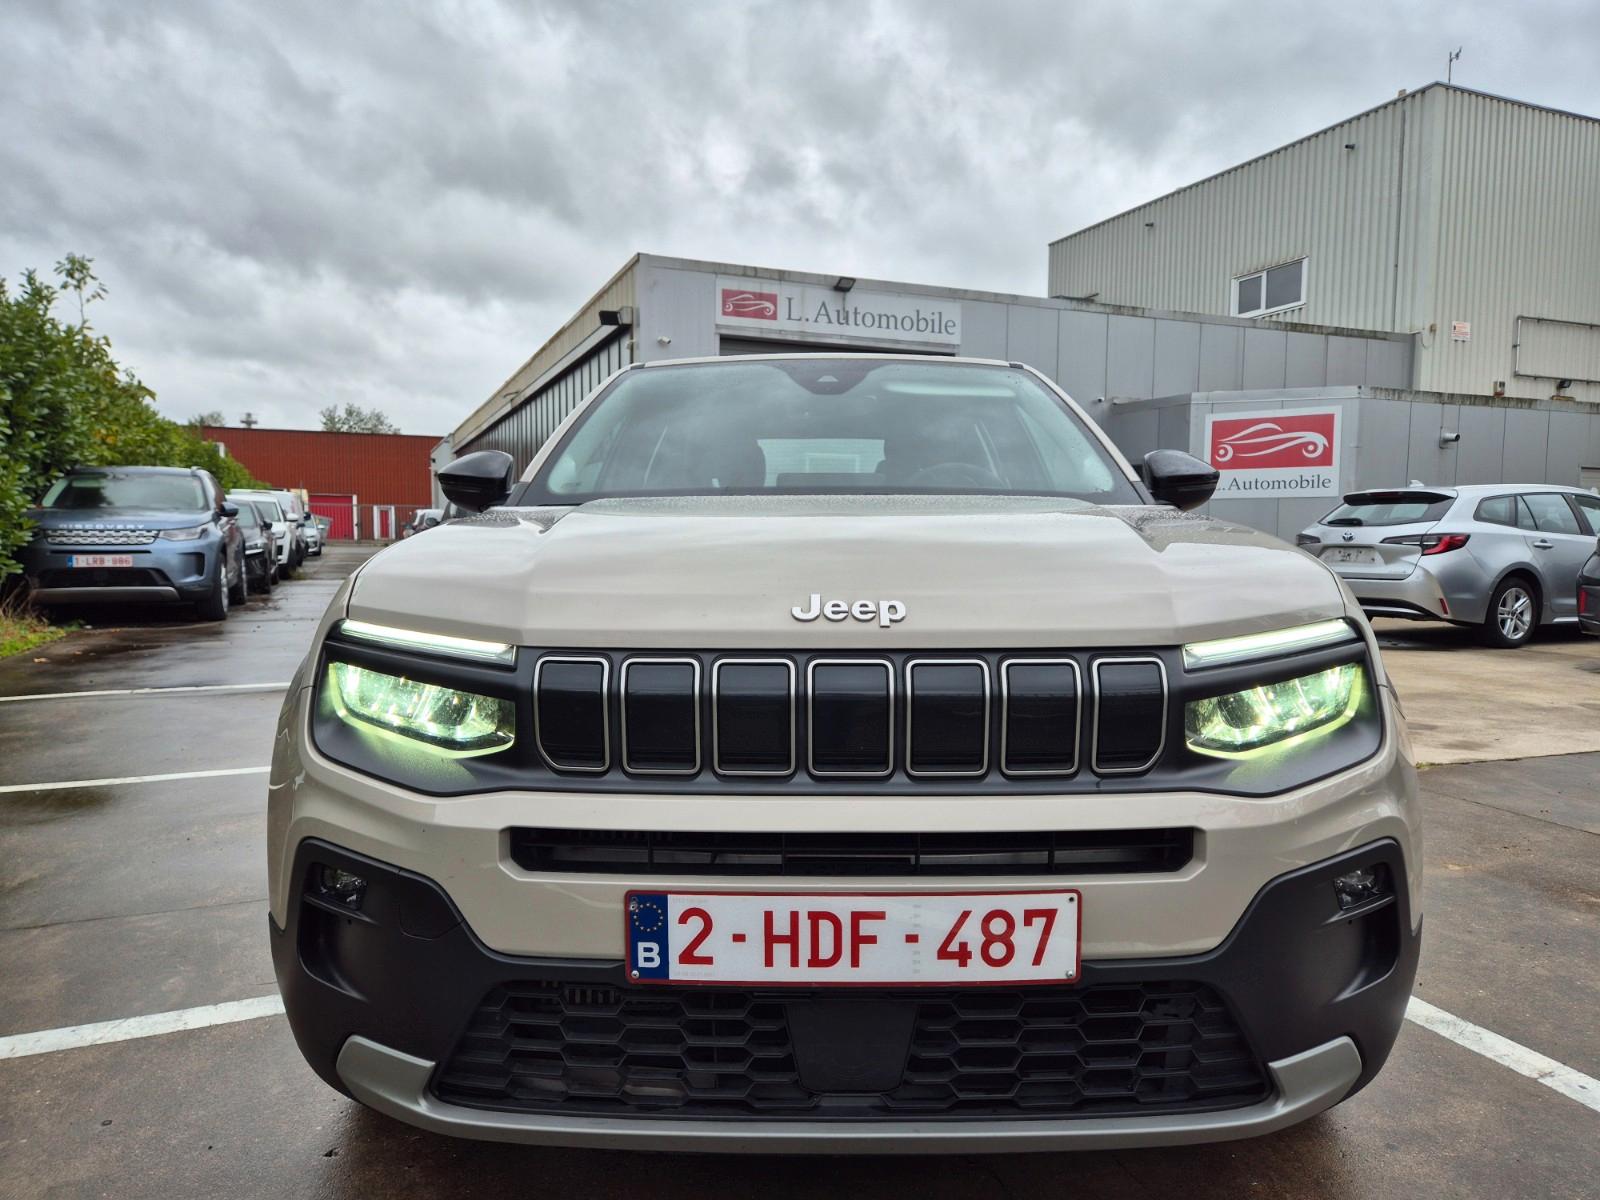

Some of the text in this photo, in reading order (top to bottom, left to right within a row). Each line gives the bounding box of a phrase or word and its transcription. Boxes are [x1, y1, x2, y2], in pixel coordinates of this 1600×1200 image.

[1217, 474, 1332, 491] .Automobile
[791, 592, 906, 628] Jeep
[637, 941, 661, 968] B
